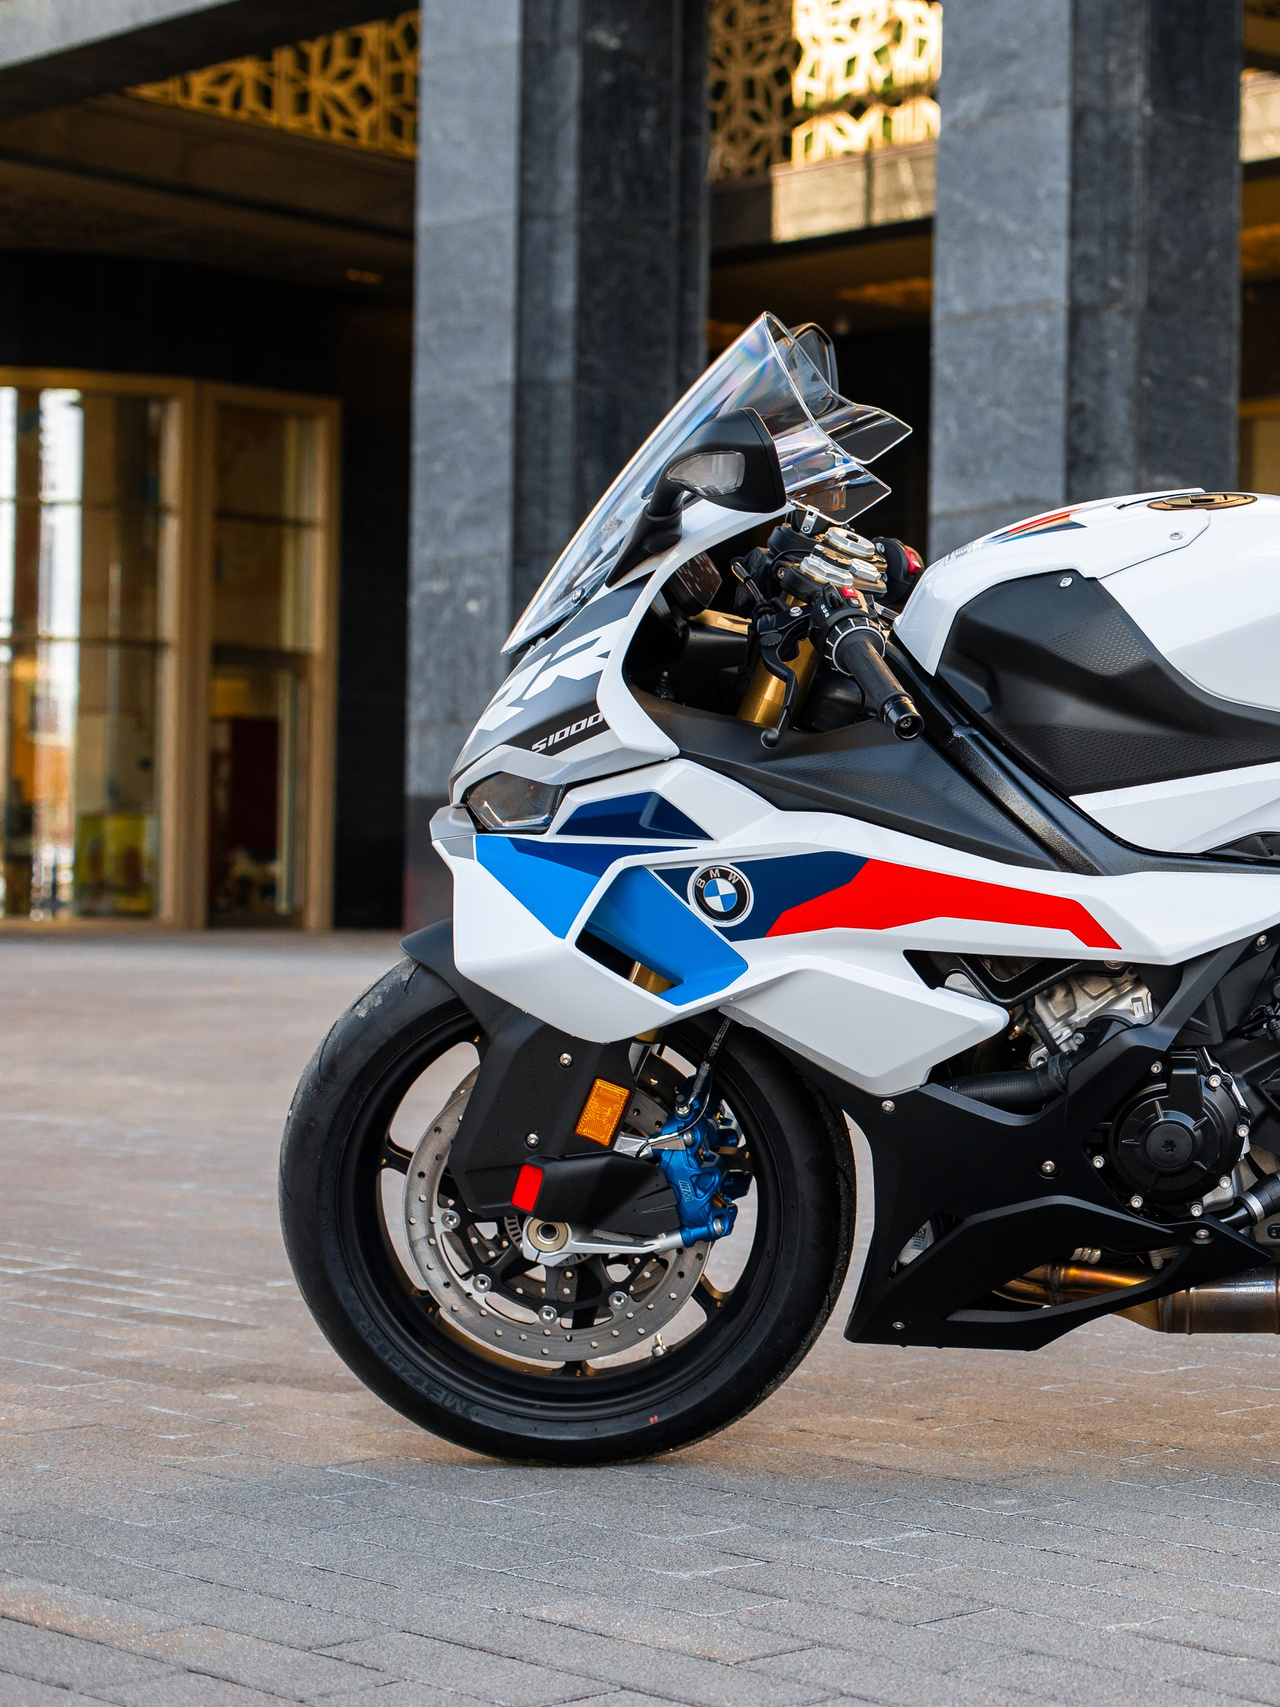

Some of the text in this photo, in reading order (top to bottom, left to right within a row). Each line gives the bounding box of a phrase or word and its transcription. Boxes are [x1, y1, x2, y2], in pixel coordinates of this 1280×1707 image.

[531, 712, 605, 754] S1000
[696, 868, 740, 889] BMW
[358, 1319, 467, 1414] METZELER
